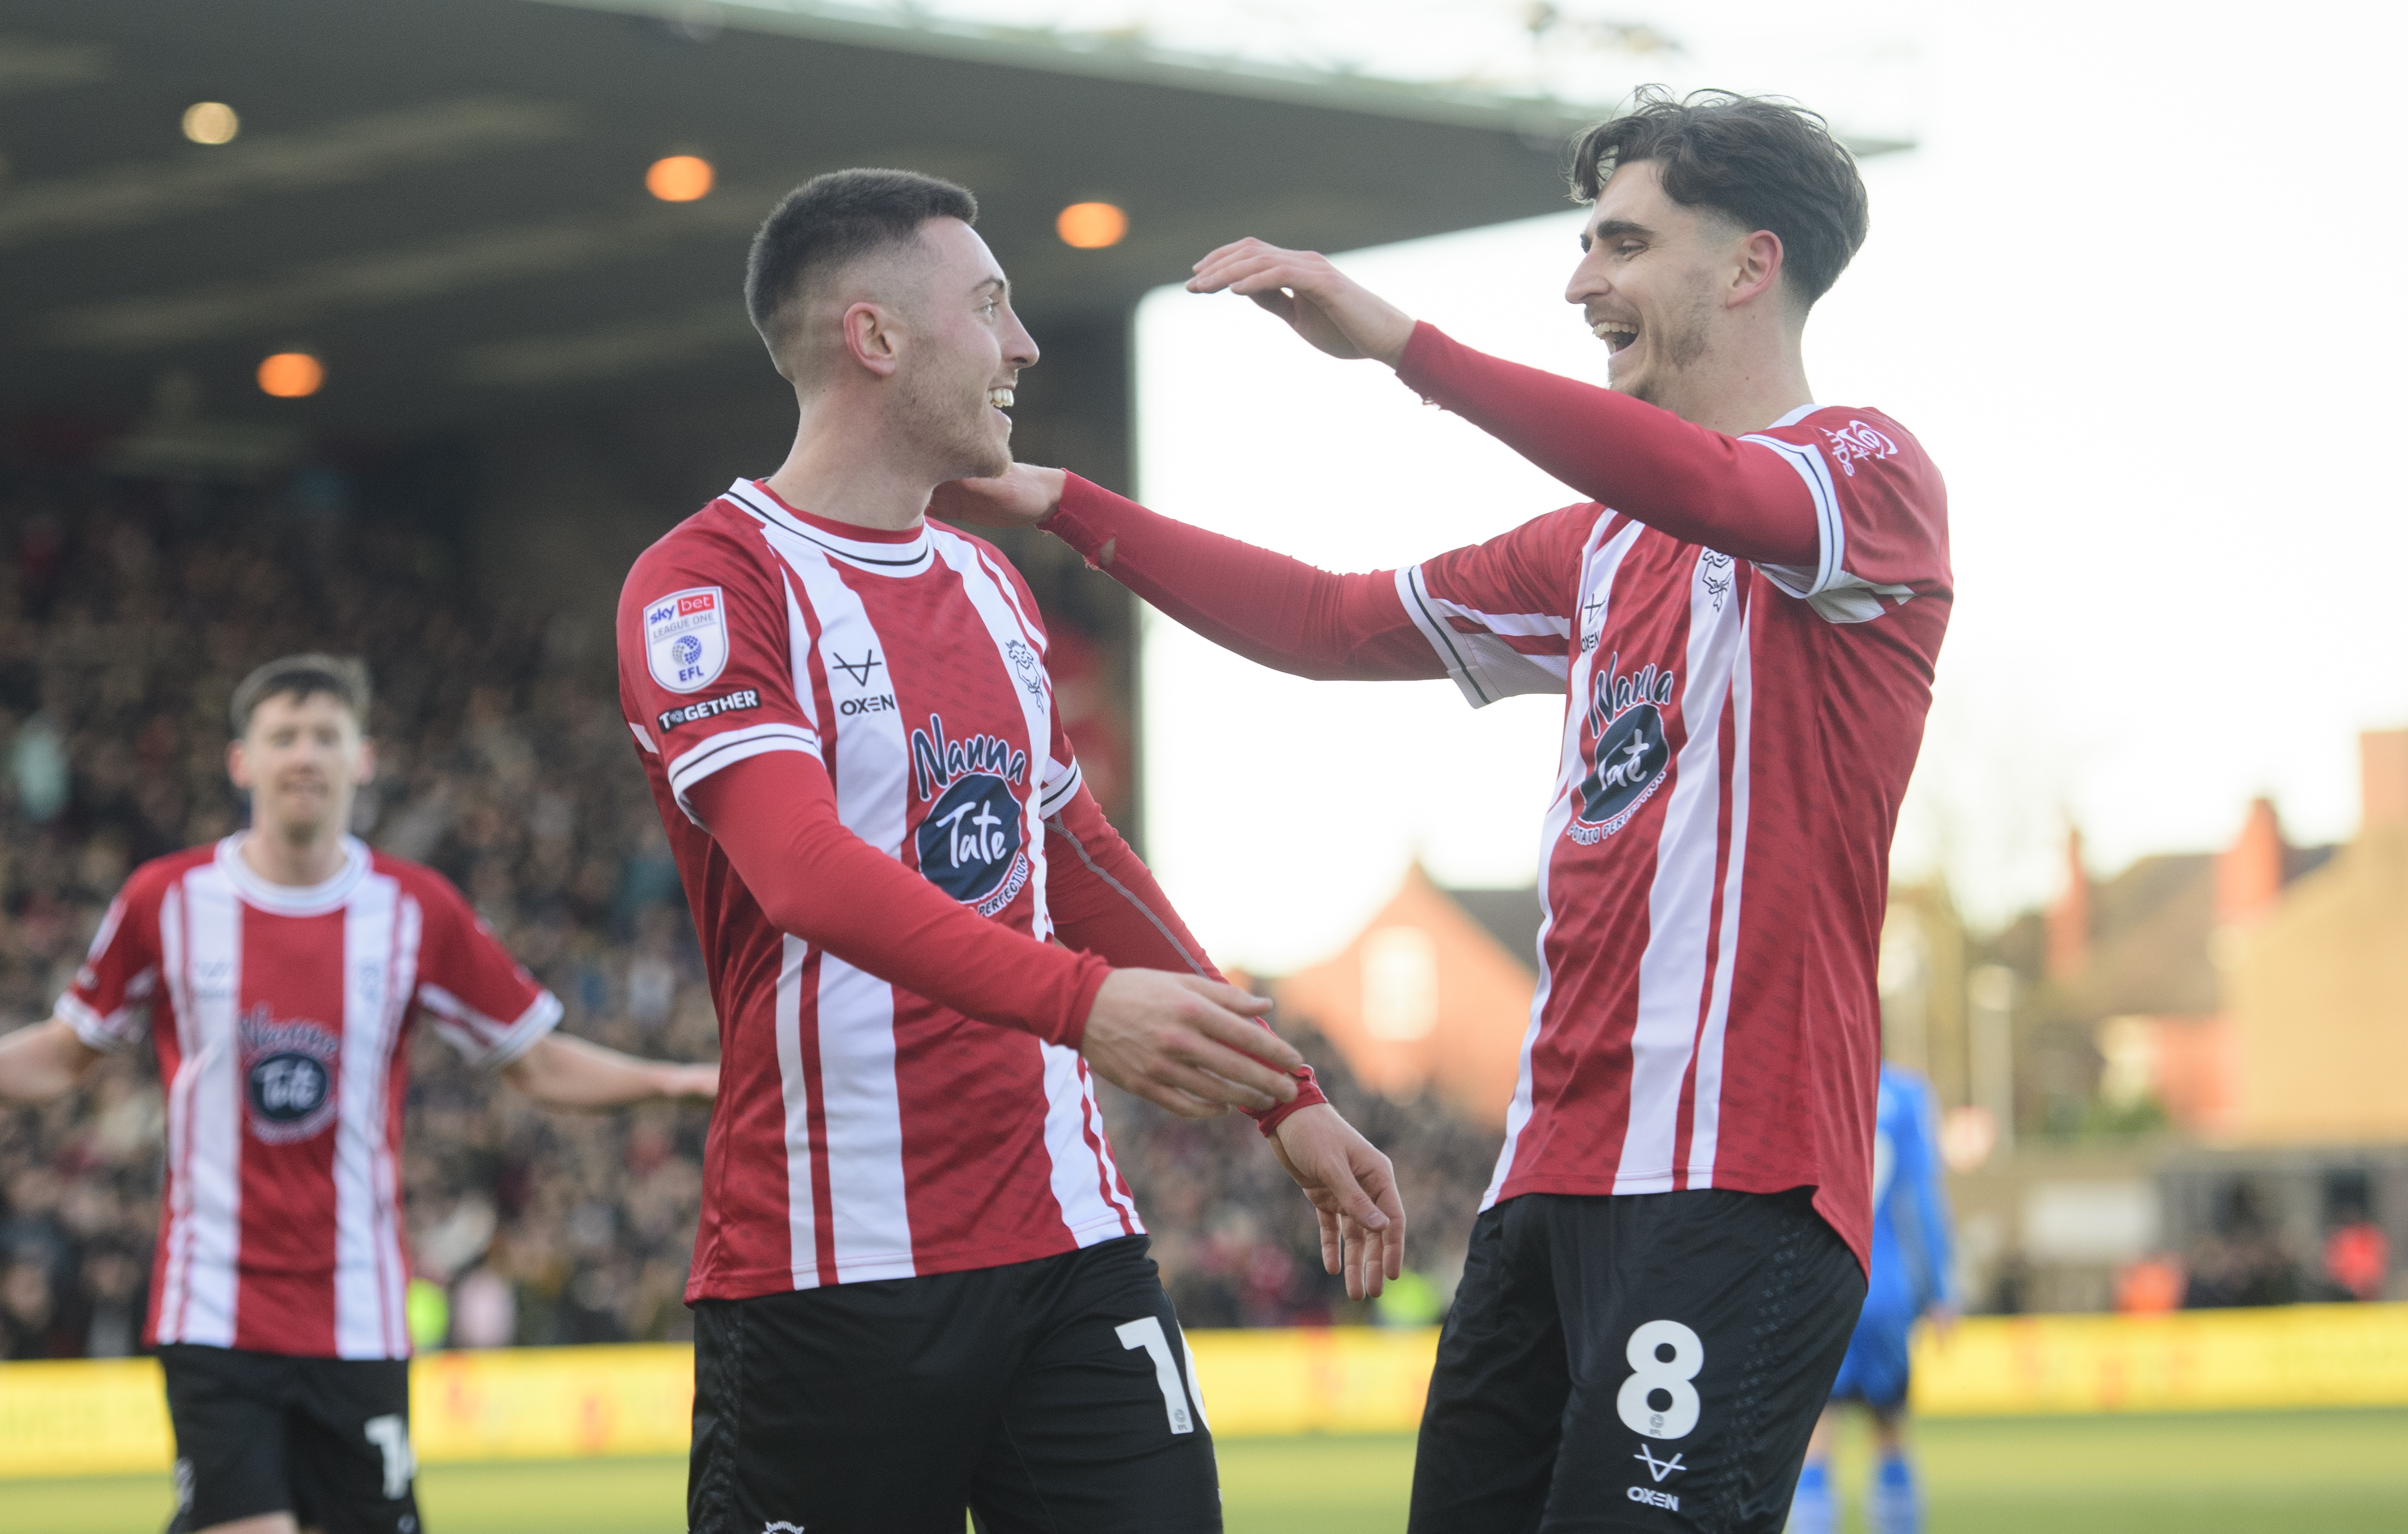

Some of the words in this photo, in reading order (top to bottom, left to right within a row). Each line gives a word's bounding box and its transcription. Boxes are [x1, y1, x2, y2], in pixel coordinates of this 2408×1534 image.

[649, 605, 675, 624] sky
[680, 596, 711, 612] bet
[654, 618, 690, 638] LEAGUE
[692, 613, 714, 624] ONE
[1581, 630, 1600, 652] OXEN
[679, 665, 704, 681] EFL
[840, 694, 896, 716] OXEN
[912, 713, 1025, 802] Nanna
[936, 801, 1007, 869] Tate
[1567, 821, 1601, 845] POTATO
[977, 853, 1028, 917] PERFECTION
[1114, 1316, 1211, 1435] 1
[1617, 1320, 1704, 1439] 8
[363, 1412, 416, 1501] 1
[1627, 1487, 1680, 1511] OXEN
